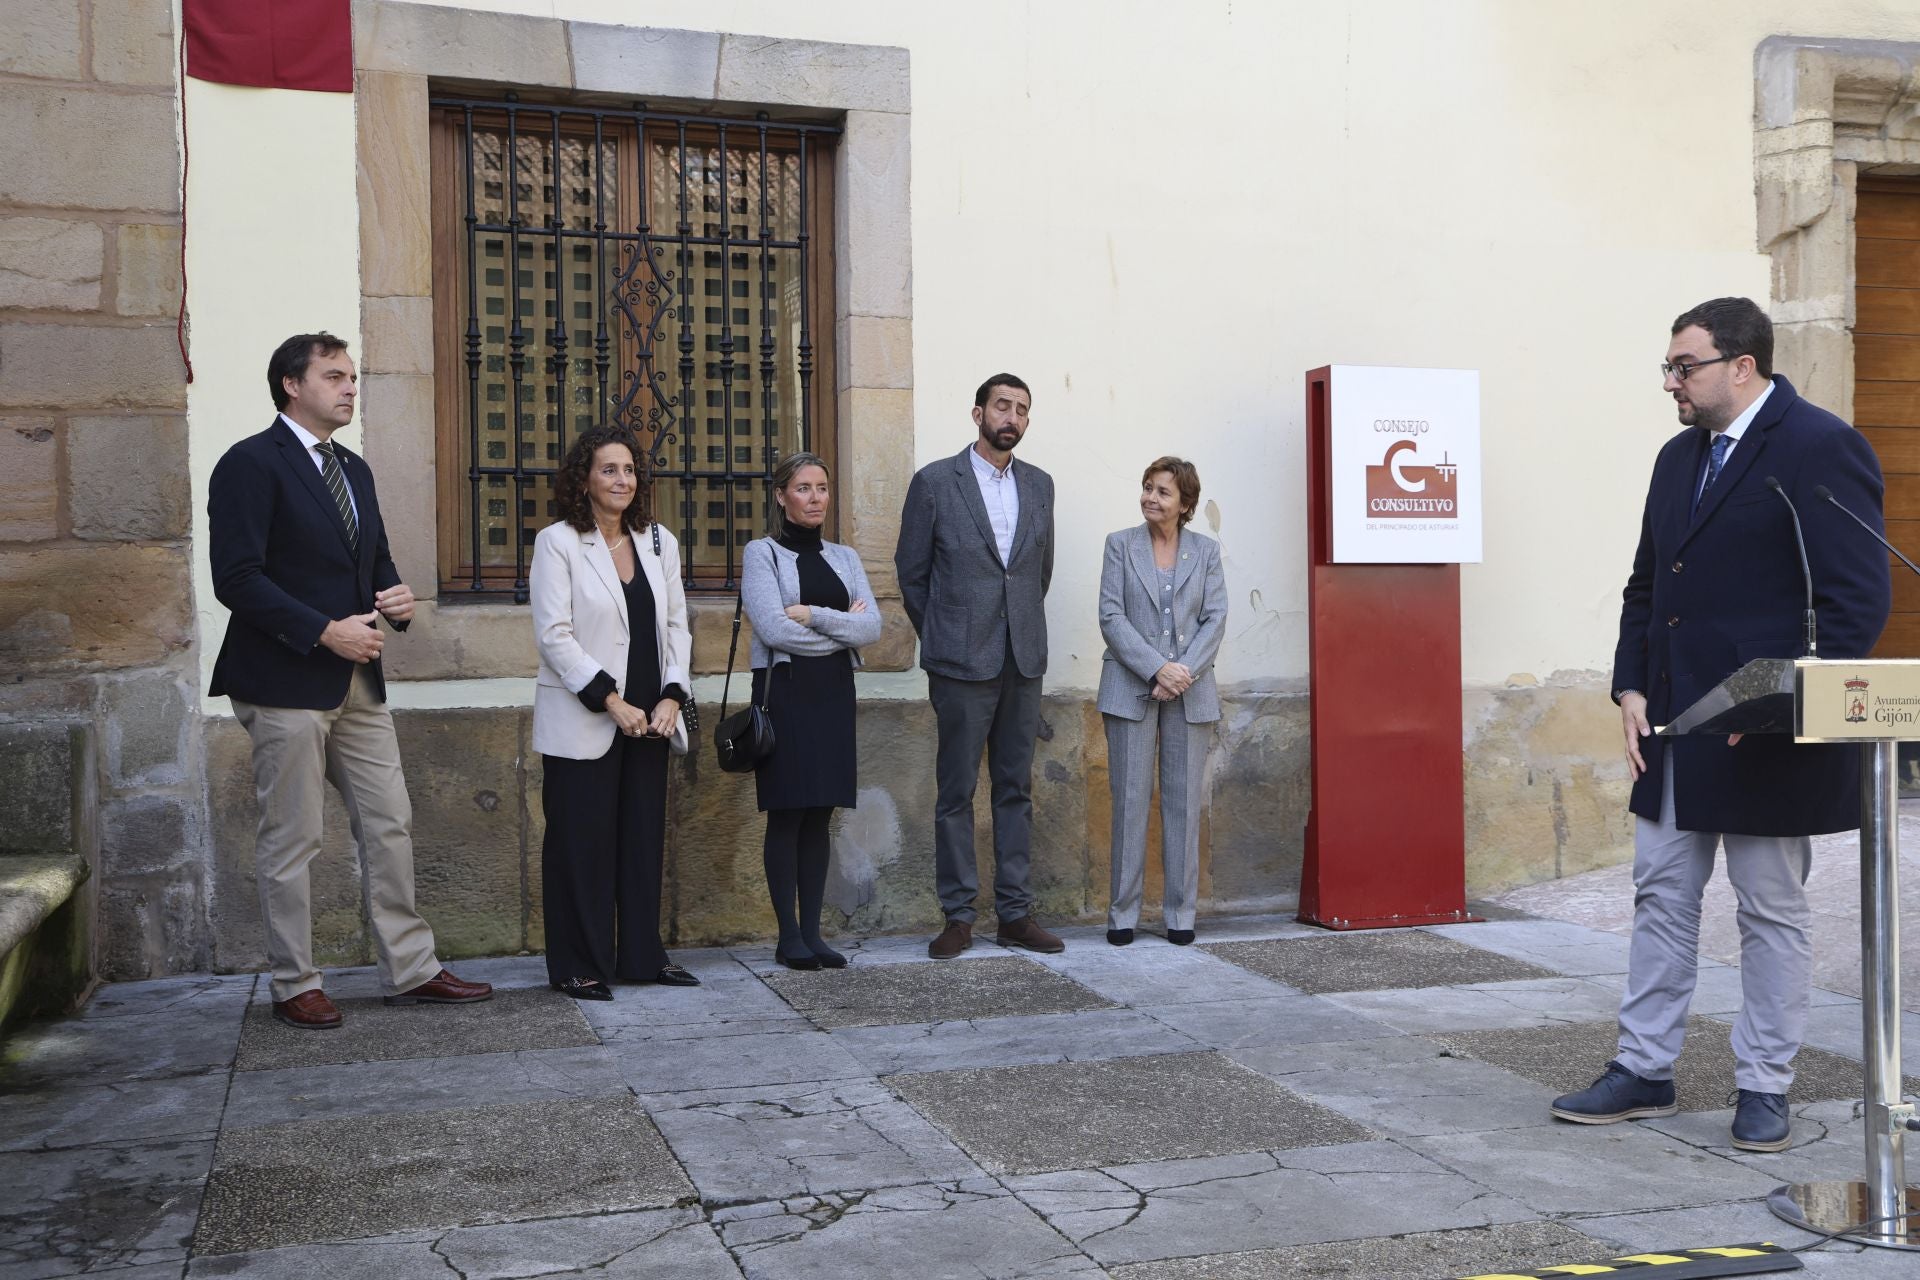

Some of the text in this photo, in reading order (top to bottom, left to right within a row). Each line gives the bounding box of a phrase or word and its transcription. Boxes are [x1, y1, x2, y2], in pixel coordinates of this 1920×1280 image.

[1374, 419, 1430, 437] CONSEJO
[1371, 498, 1454, 512] CONSULTIVO
[1366, 523, 1459, 531] DEL PRINCIPADO DE ASTURIAS
